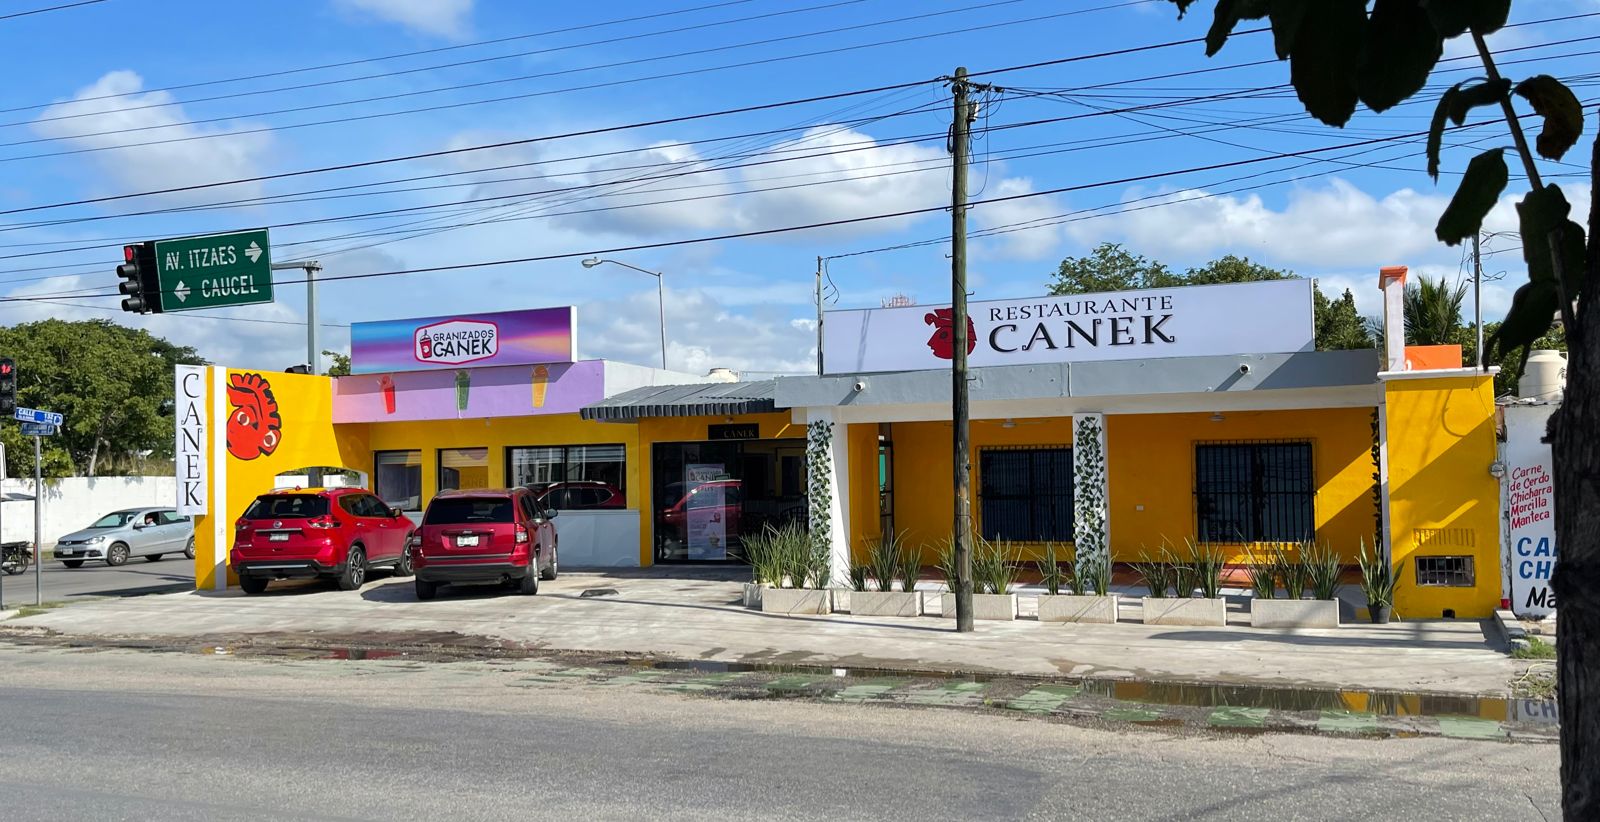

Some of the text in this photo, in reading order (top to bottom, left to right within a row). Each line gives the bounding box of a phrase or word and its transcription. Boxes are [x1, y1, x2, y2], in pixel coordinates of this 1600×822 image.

[165, 245, 237, 271] AV. ITZAES
[201, 274, 260, 298] CAUCEL
[989, 295, 1173, 322] RESTAURANTE
[432, 329, 495, 342] GRANIZADOS
[988, 313, 1176, 353] CANEK
[432, 338, 493, 358] CANEK
[180, 372, 203, 507] CANEK
[1509, 471, 1550, 491] de Cerdo
[1511, 464, 1542, 480] Carne
[1510, 497, 1547, 517] Morcilla
[1511, 510, 1550, 531] Manteca
